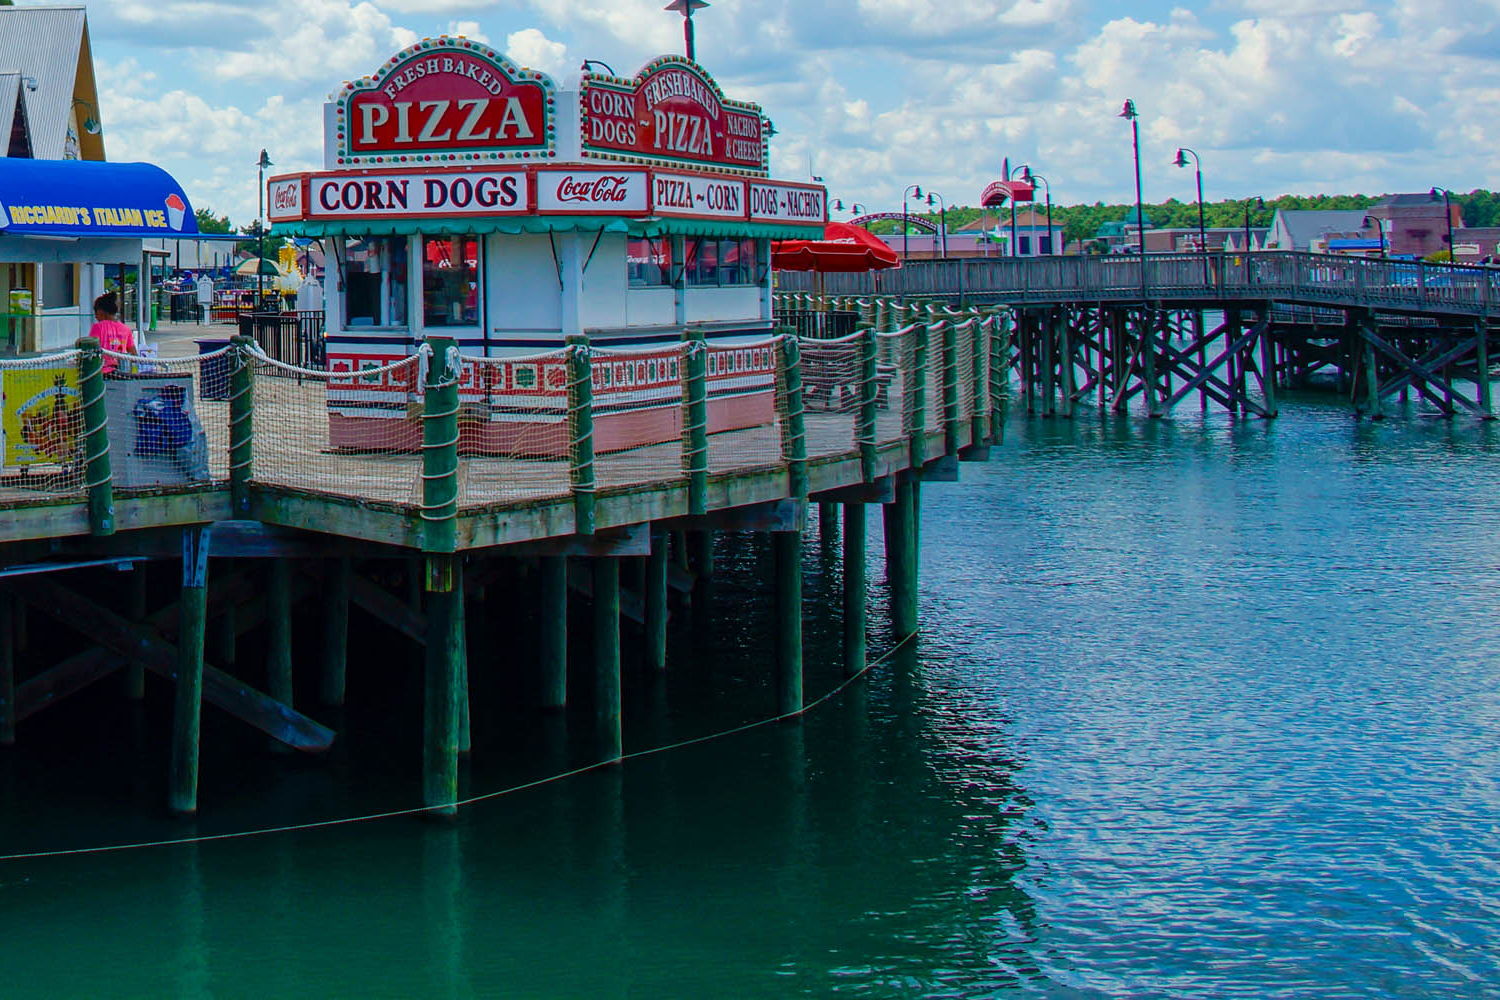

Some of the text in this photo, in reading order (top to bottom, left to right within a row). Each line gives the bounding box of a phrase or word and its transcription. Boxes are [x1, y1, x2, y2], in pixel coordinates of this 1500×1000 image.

[384, 58, 503, 100] FRESH BAKED
[591, 90, 636, 120] CORN
[644, 72, 719, 120] FRESH BAKED
[358, 96, 534, 144] PIZZA
[591, 117, 636, 146] DOGS
[653, 110, 713, 156] PIZZA
[727, 114, 758, 138] NACHOS
[732, 140, 761, 162] CHEESE
[319, 176, 518, 211] CORN DOGS
[556, 175, 630, 203] Coca-Cola
[656, 178, 739, 212] PIZZA CORN
[752, 187, 821, 218] DOGS NACHOS
[9, 206, 168, 228] RICCIARDI'S ITALIAN ICE
